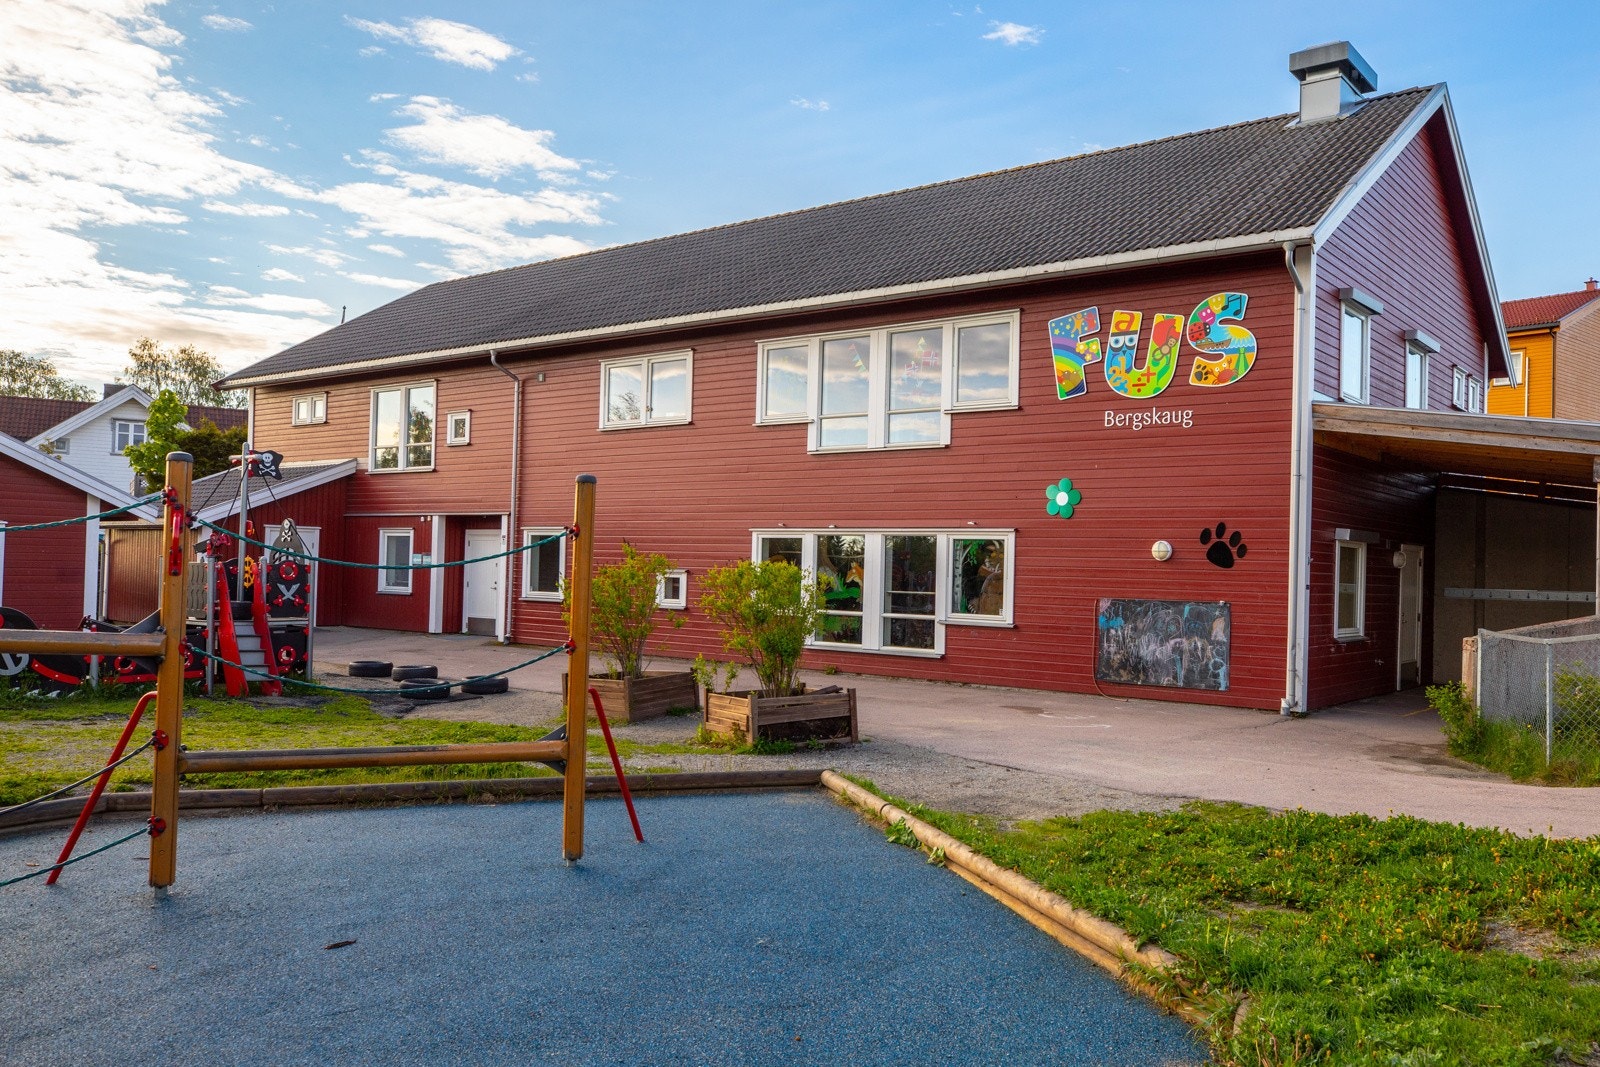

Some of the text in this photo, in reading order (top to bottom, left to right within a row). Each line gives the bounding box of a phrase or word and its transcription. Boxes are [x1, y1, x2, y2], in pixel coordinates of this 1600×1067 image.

[1115, 312, 1135, 332] a
[1048, 292, 1257, 400] FUS
[1104, 407, 1193, 430] Bergskaug
